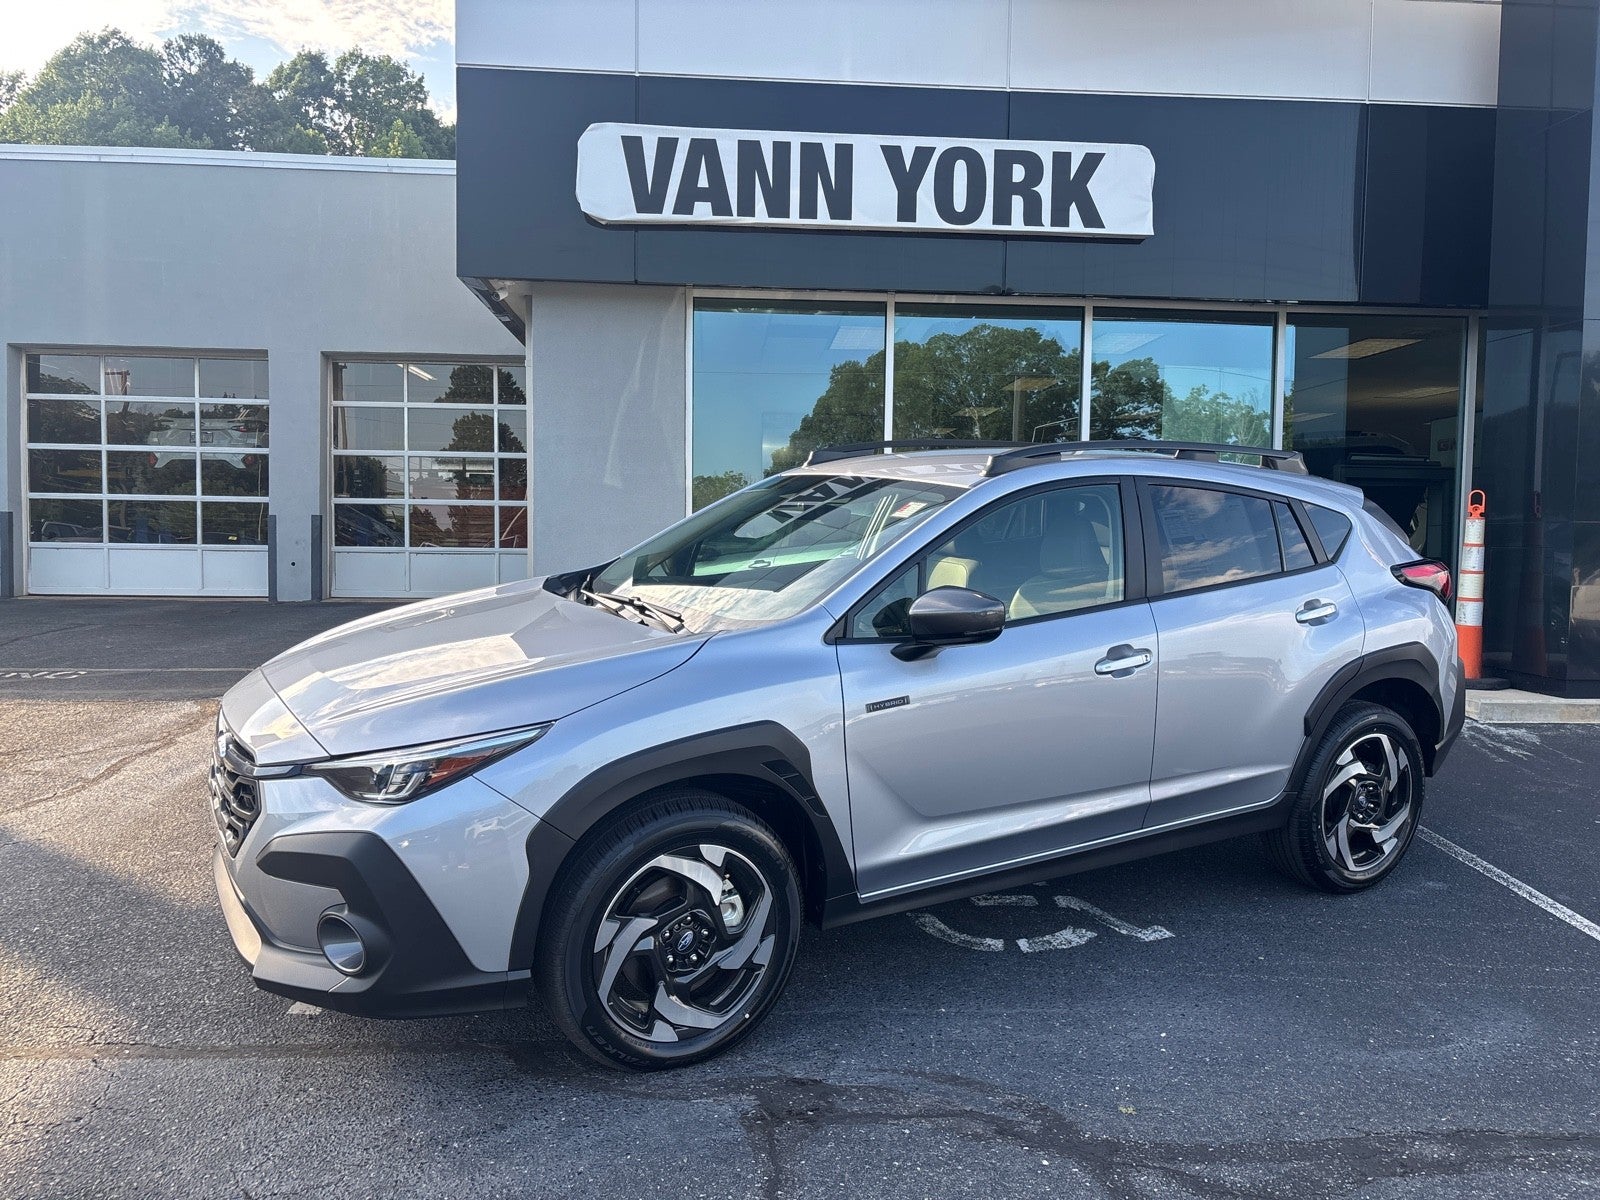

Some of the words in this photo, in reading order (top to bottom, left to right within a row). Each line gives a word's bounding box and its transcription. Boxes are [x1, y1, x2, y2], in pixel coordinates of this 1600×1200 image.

[620, 135, 853, 220] VANN
[880, 144, 1106, 229] YORK
[872, 698, 905, 710] HYBRID
